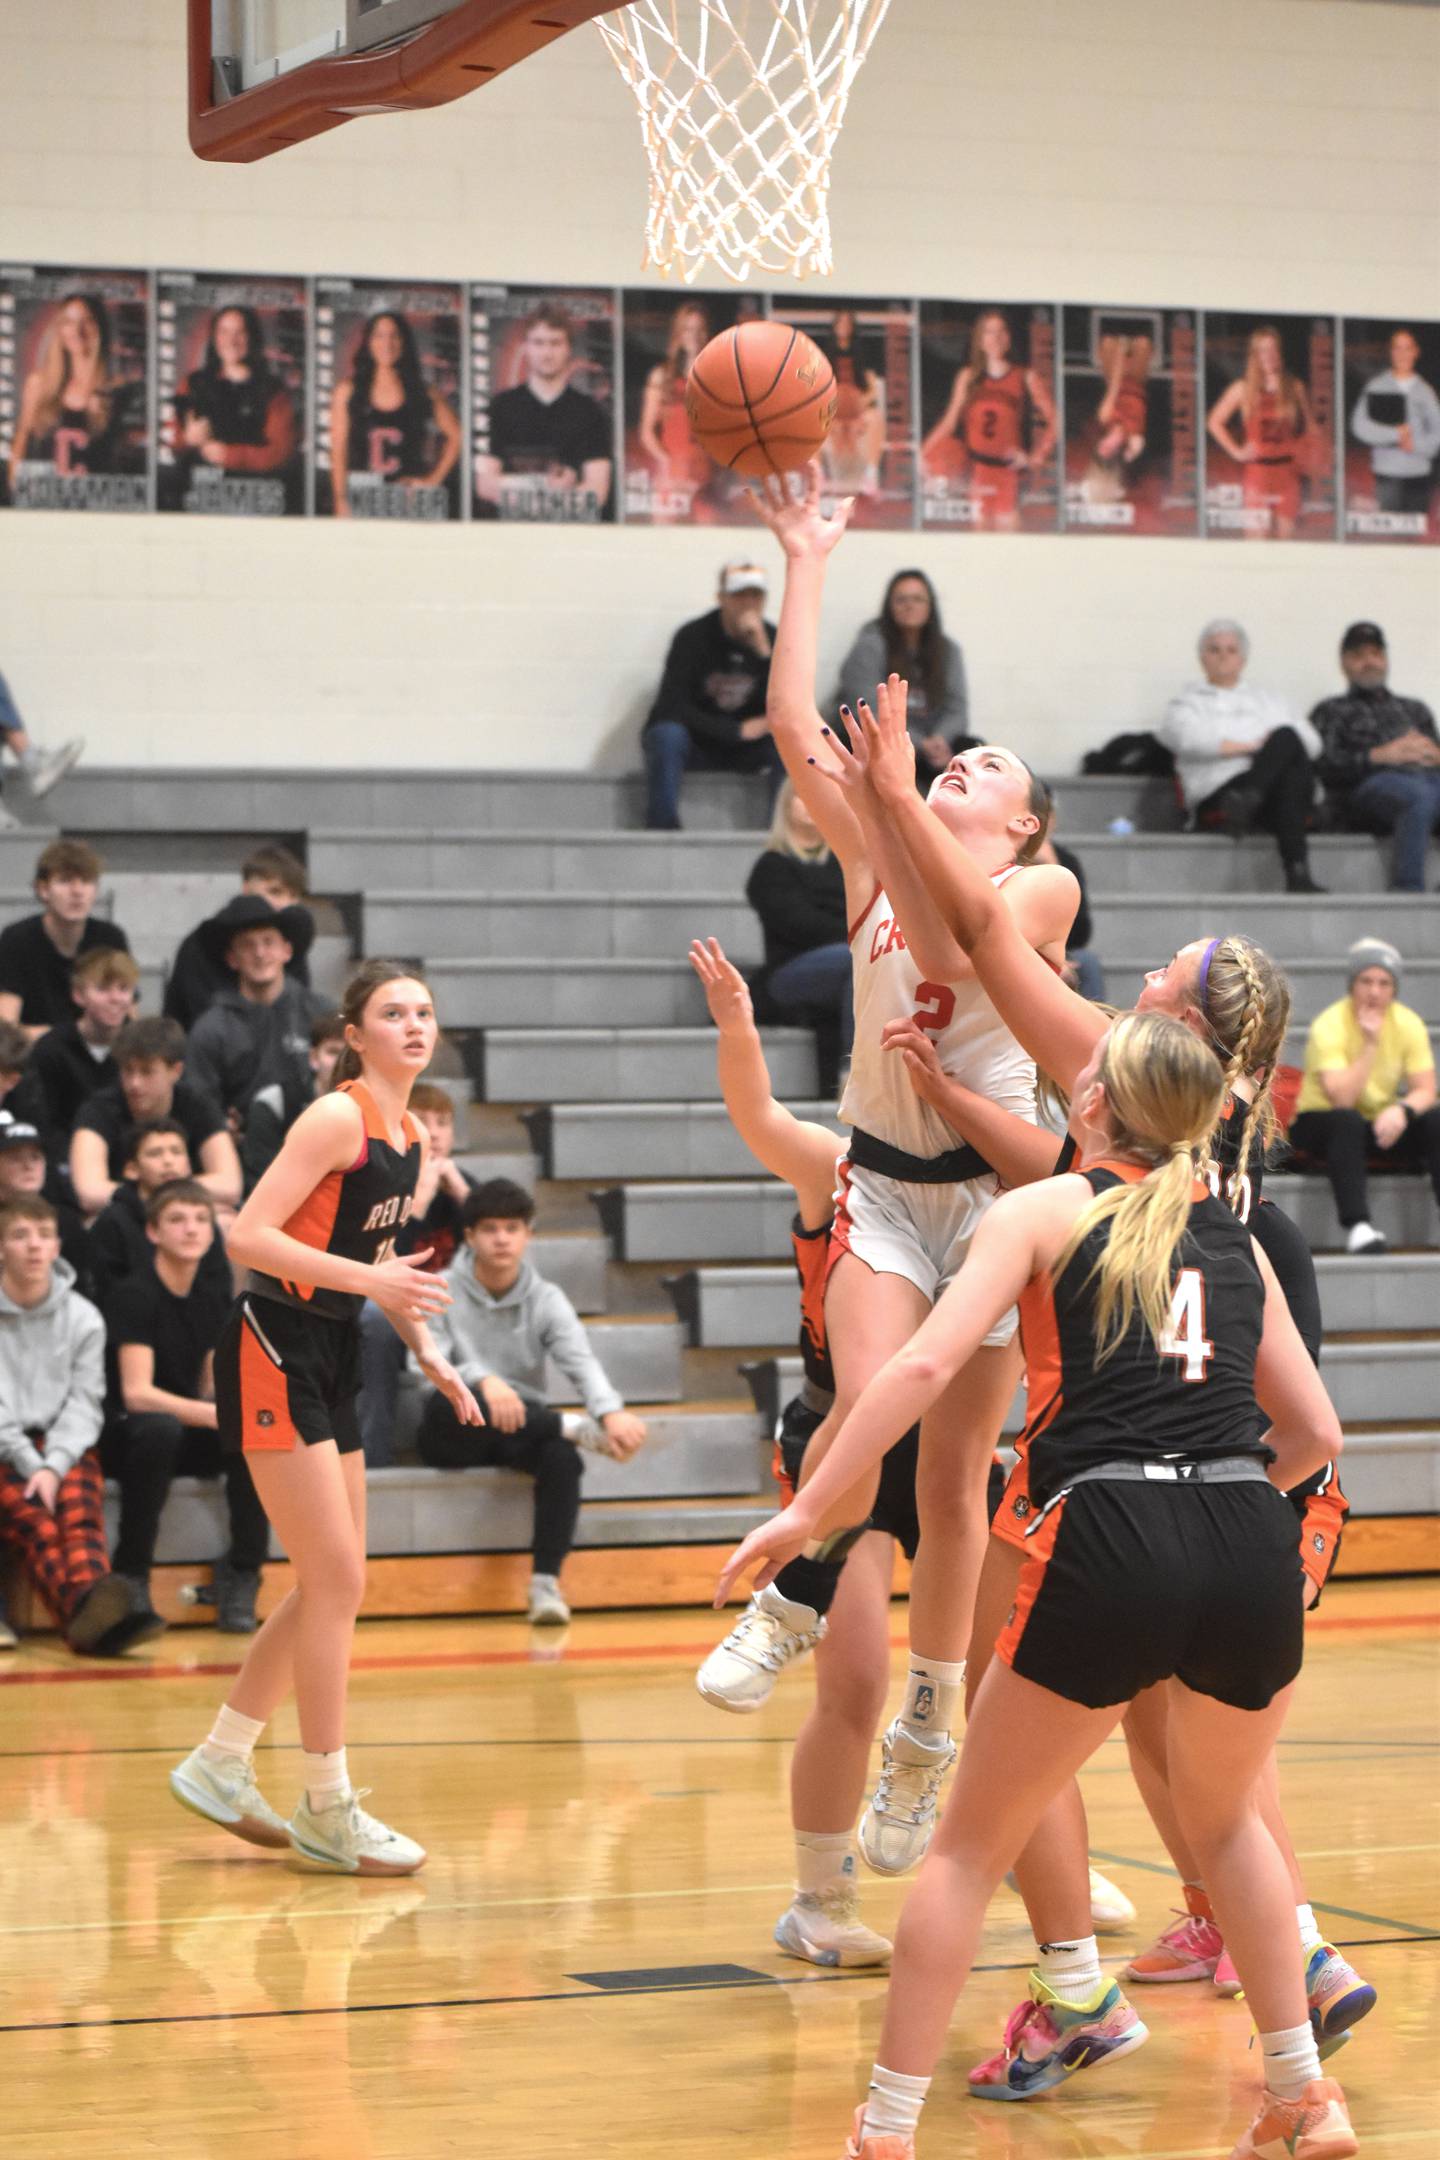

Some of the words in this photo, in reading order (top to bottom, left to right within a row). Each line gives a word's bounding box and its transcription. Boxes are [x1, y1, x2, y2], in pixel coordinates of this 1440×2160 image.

[367, 427, 403, 474] C
[912, 981, 957, 1048] 2
[362, 1195, 400, 1232] RED
[1158, 1267, 1215, 1384] 4
